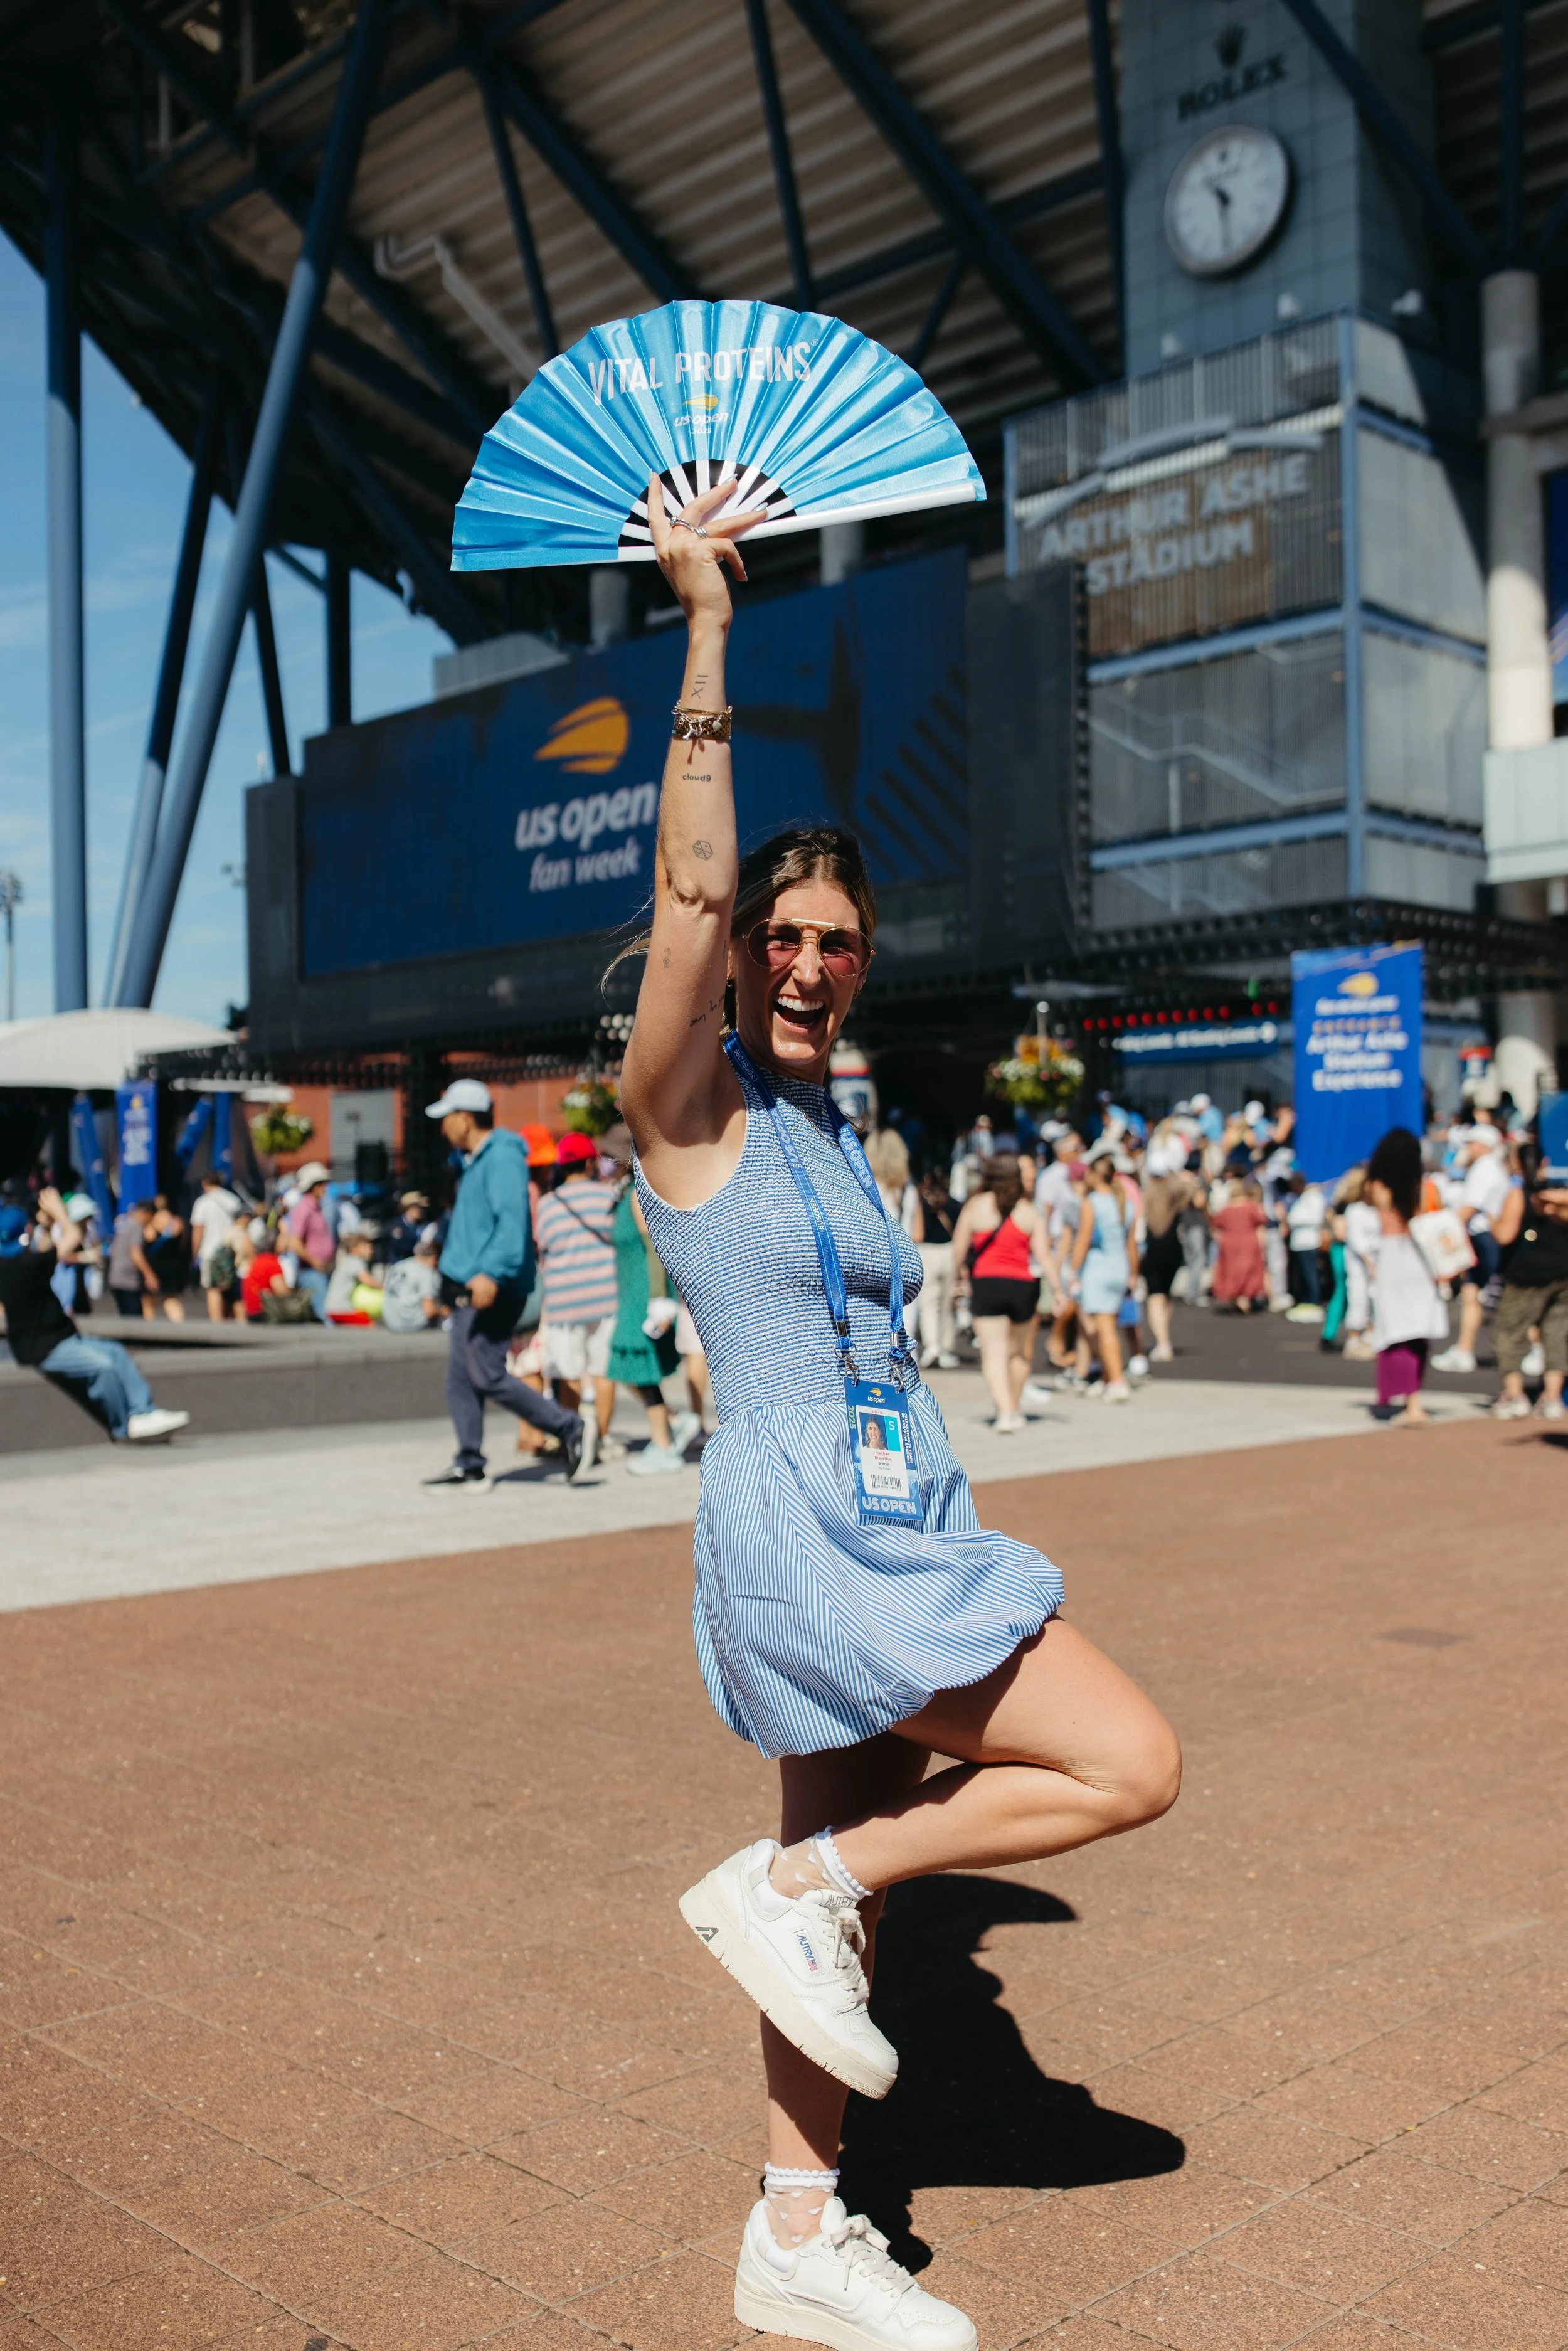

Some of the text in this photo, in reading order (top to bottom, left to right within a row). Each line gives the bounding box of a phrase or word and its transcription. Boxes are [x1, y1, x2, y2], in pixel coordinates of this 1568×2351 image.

[1178, 53, 1286, 121] ROLEX
[588, 357, 664, 406] VITAL
[1039, 454, 1308, 562] ARTHUR ASHE
[1086, 519, 1253, 597] STADIUM
[682, 773, 711, 782] cloud9
[515, 781, 659, 851] us open
[529, 837, 641, 893] fan week
[809, 1198, 825, 1230] #USOPEN
[847, 1404, 856, 1430] 2025
[888, 1420, 895, 1431] S
[825, 1894, 854, 1907] AUTRY
[797, 1933, 814, 1959] AUTRY
